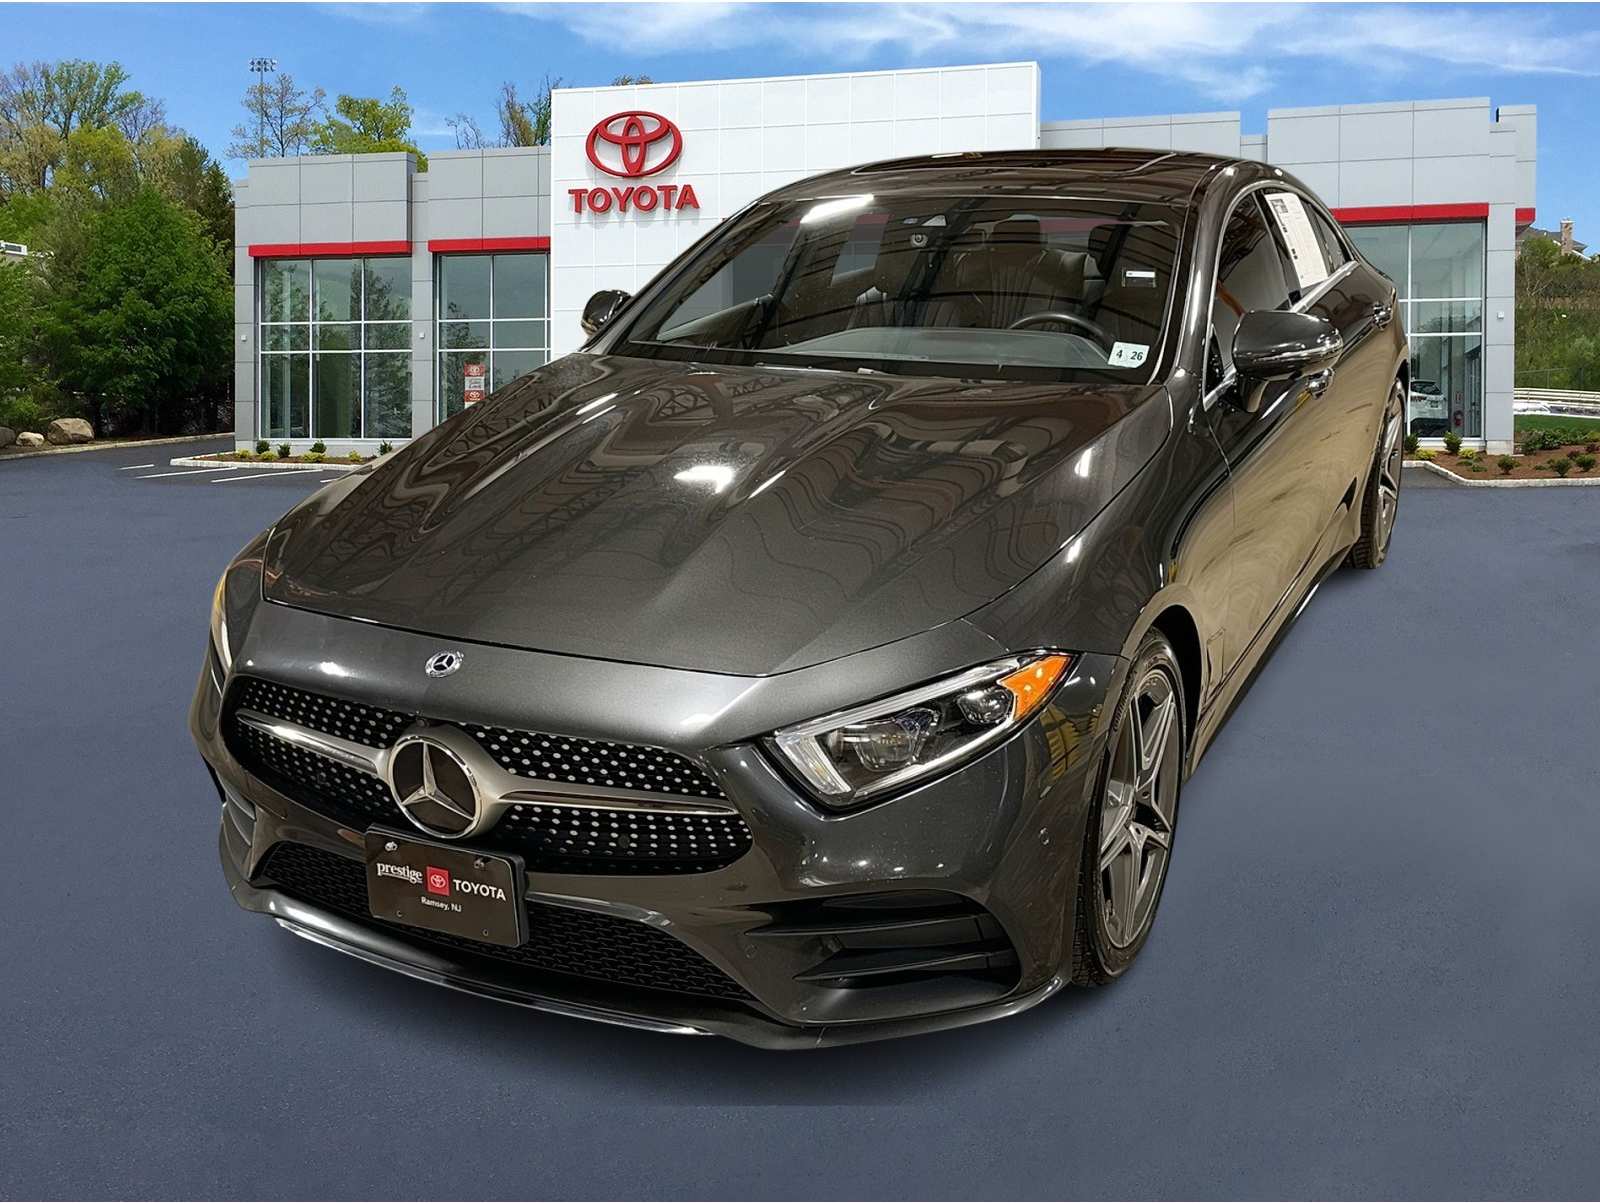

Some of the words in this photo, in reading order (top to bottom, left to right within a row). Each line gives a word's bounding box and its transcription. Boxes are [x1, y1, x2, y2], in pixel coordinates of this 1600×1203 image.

[568, 184, 700, 213] TOYOTA
[1116, 349, 1123, 359] 4
[1130, 351, 1143, 361] 26
[376, 862, 423, 884] prestige
[453, 879, 506, 901] TOYOTA
[421, 896, 450, 911] Ramsey,
[451, 903, 462, 912] NJ
